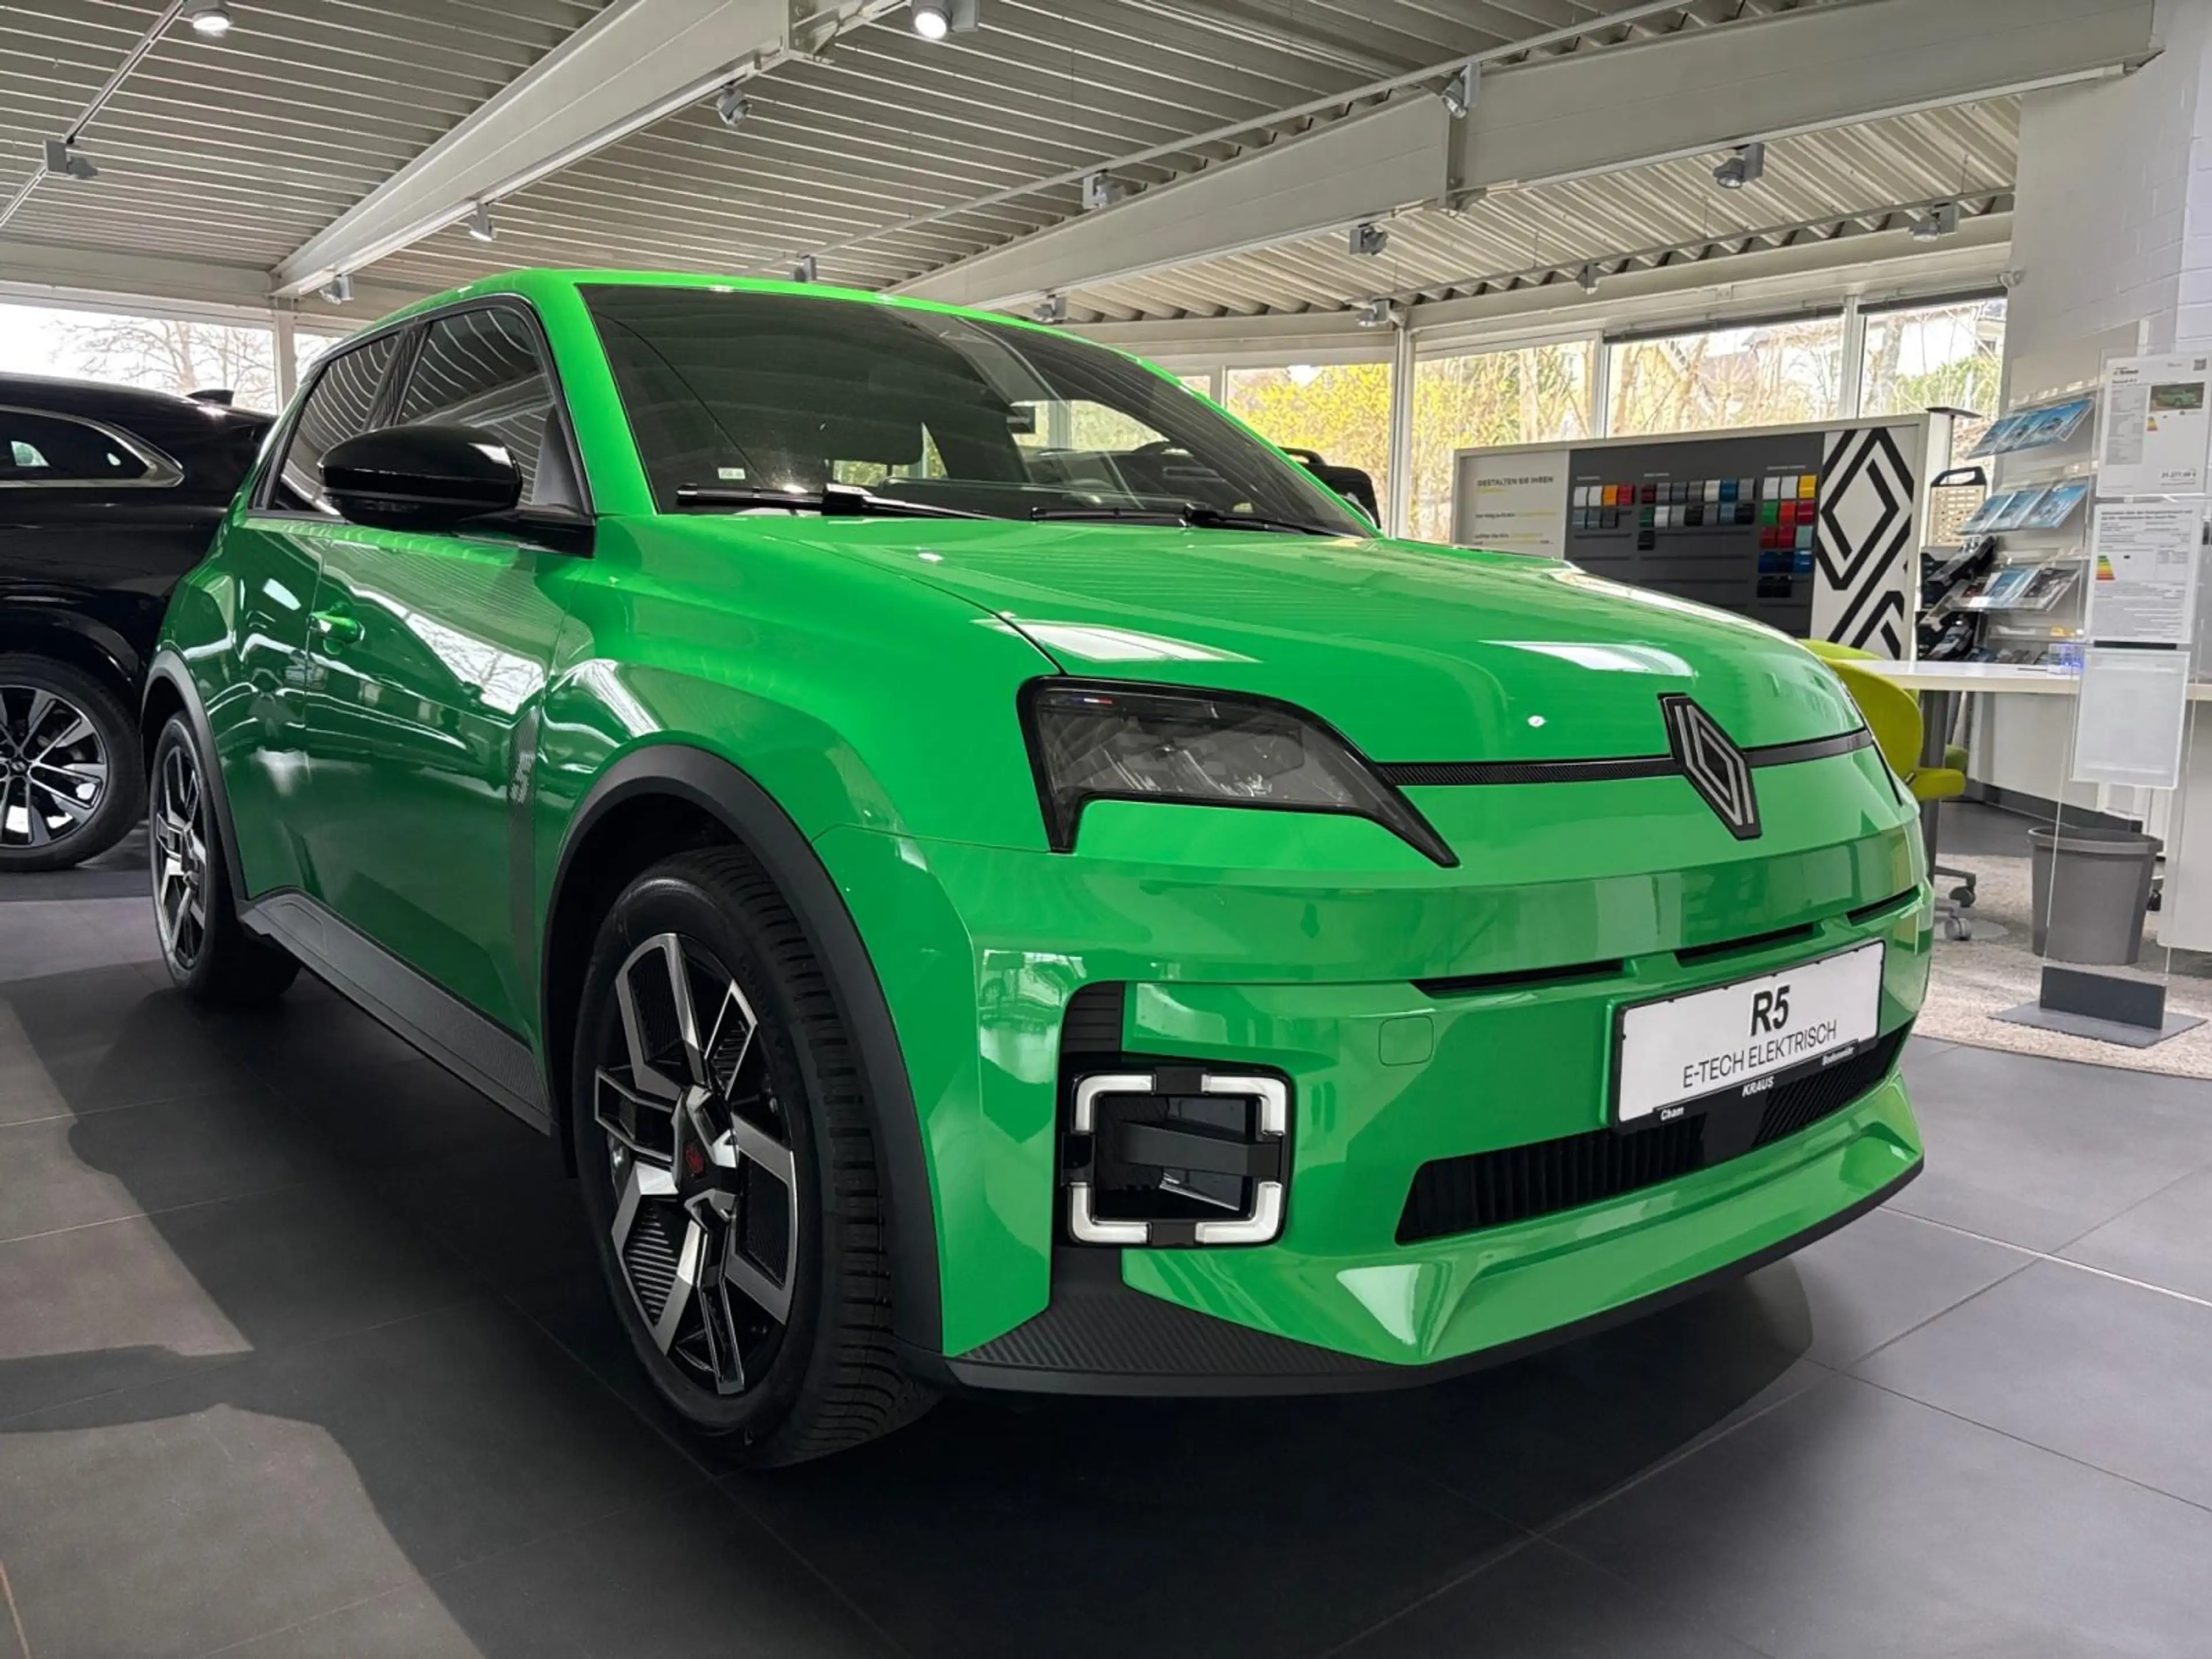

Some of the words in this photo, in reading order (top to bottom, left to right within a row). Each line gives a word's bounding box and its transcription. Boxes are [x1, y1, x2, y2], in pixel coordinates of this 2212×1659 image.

[1750, 984, 1790, 1037] R5
[1683, 1050, 1744, 1088] E-TECH
[1748, 1018, 1837, 1069] ELEKTRISCH
[1742, 1075, 1775, 1097] KRAUS
[1661, 1107, 1684, 1121] Cham
